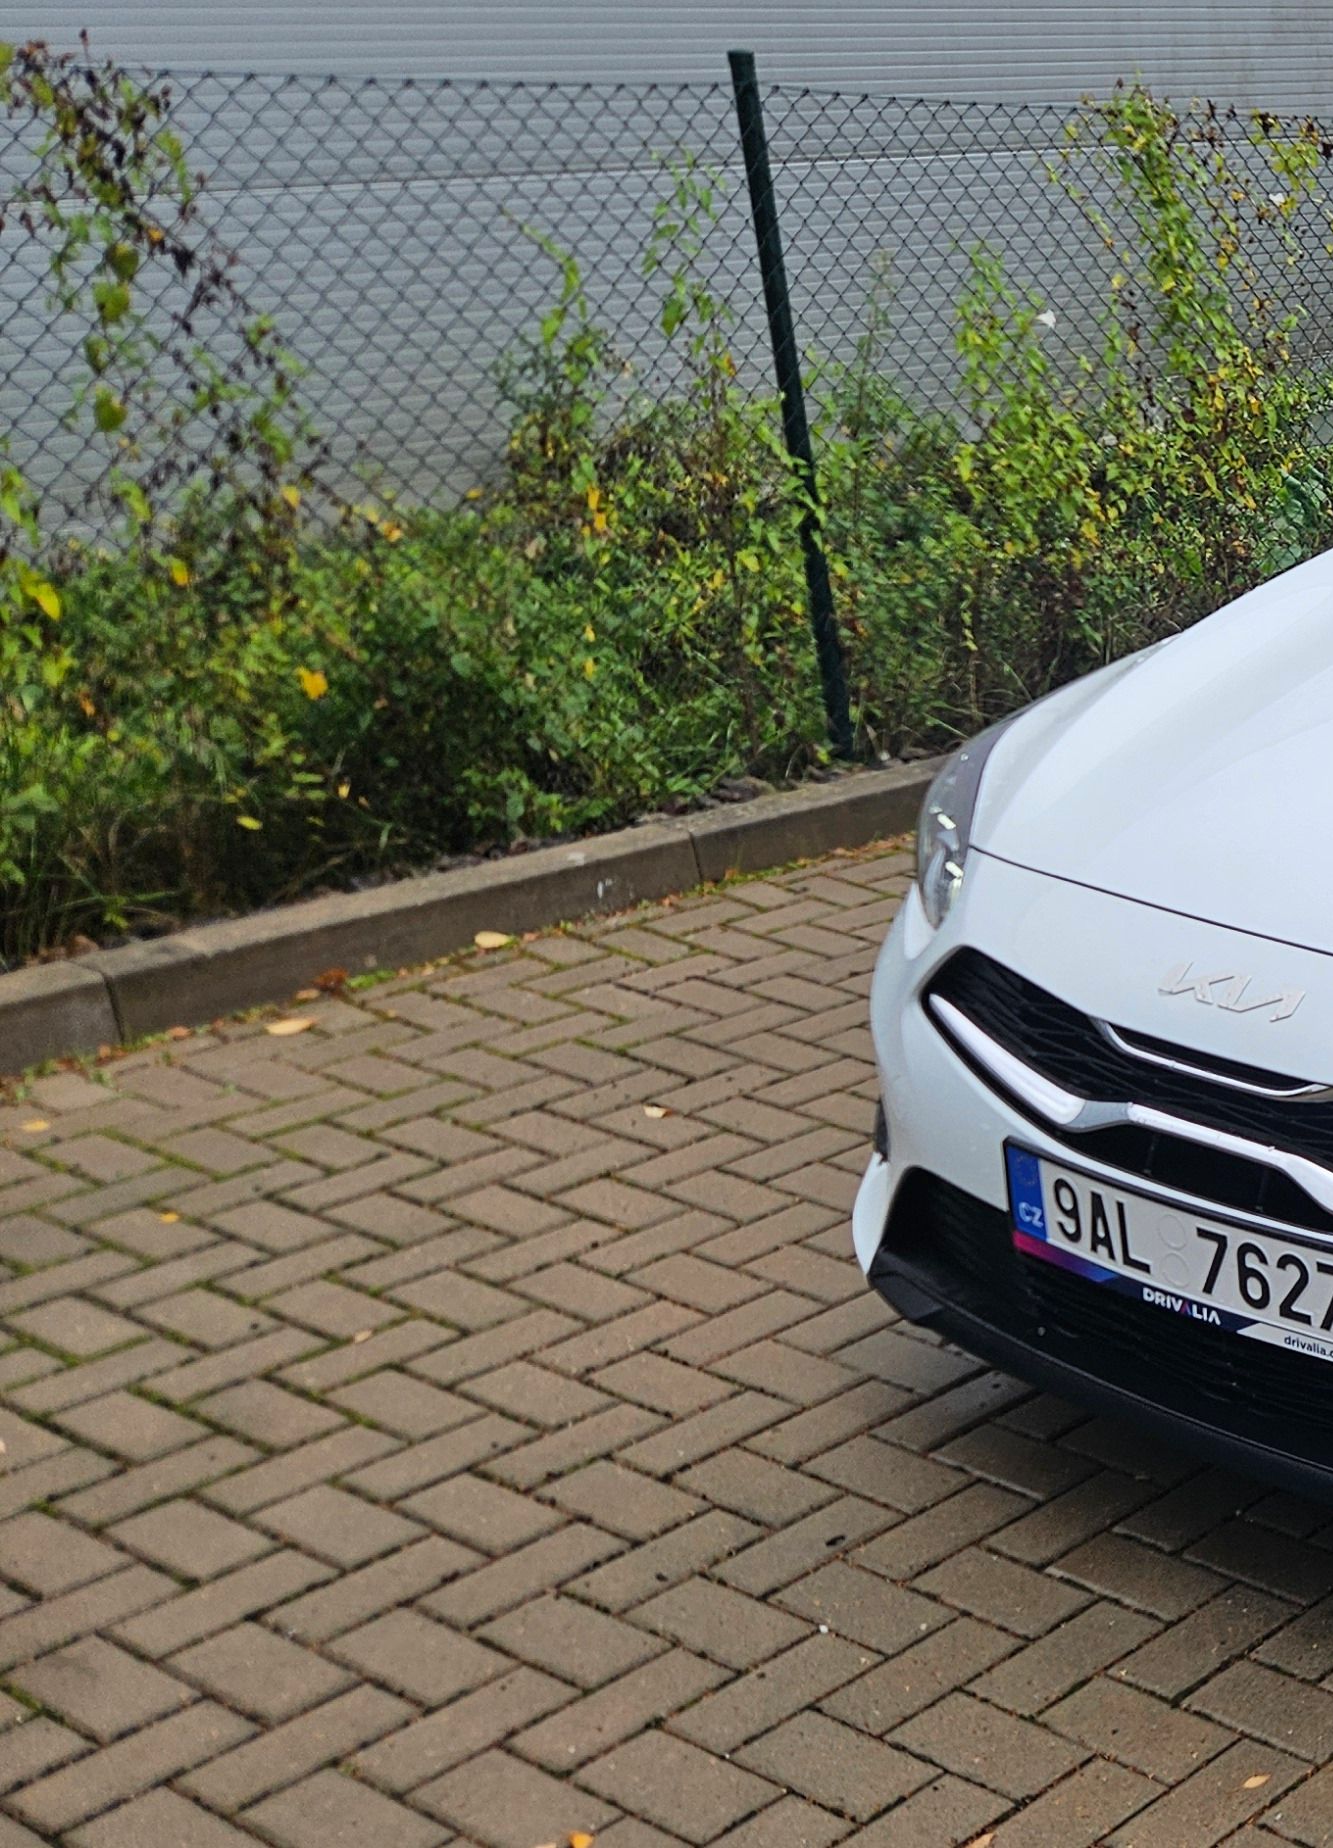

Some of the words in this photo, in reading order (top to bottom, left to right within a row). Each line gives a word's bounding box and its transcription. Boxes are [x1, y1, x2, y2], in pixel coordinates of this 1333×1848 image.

[1157, 960, 1306, 1023] KIA
[1018, 1202, 1044, 1228] CZ
[1054, 1178, 1151, 1274] 9AL
[1143, 1287, 1221, 1326] DRIVALIA
